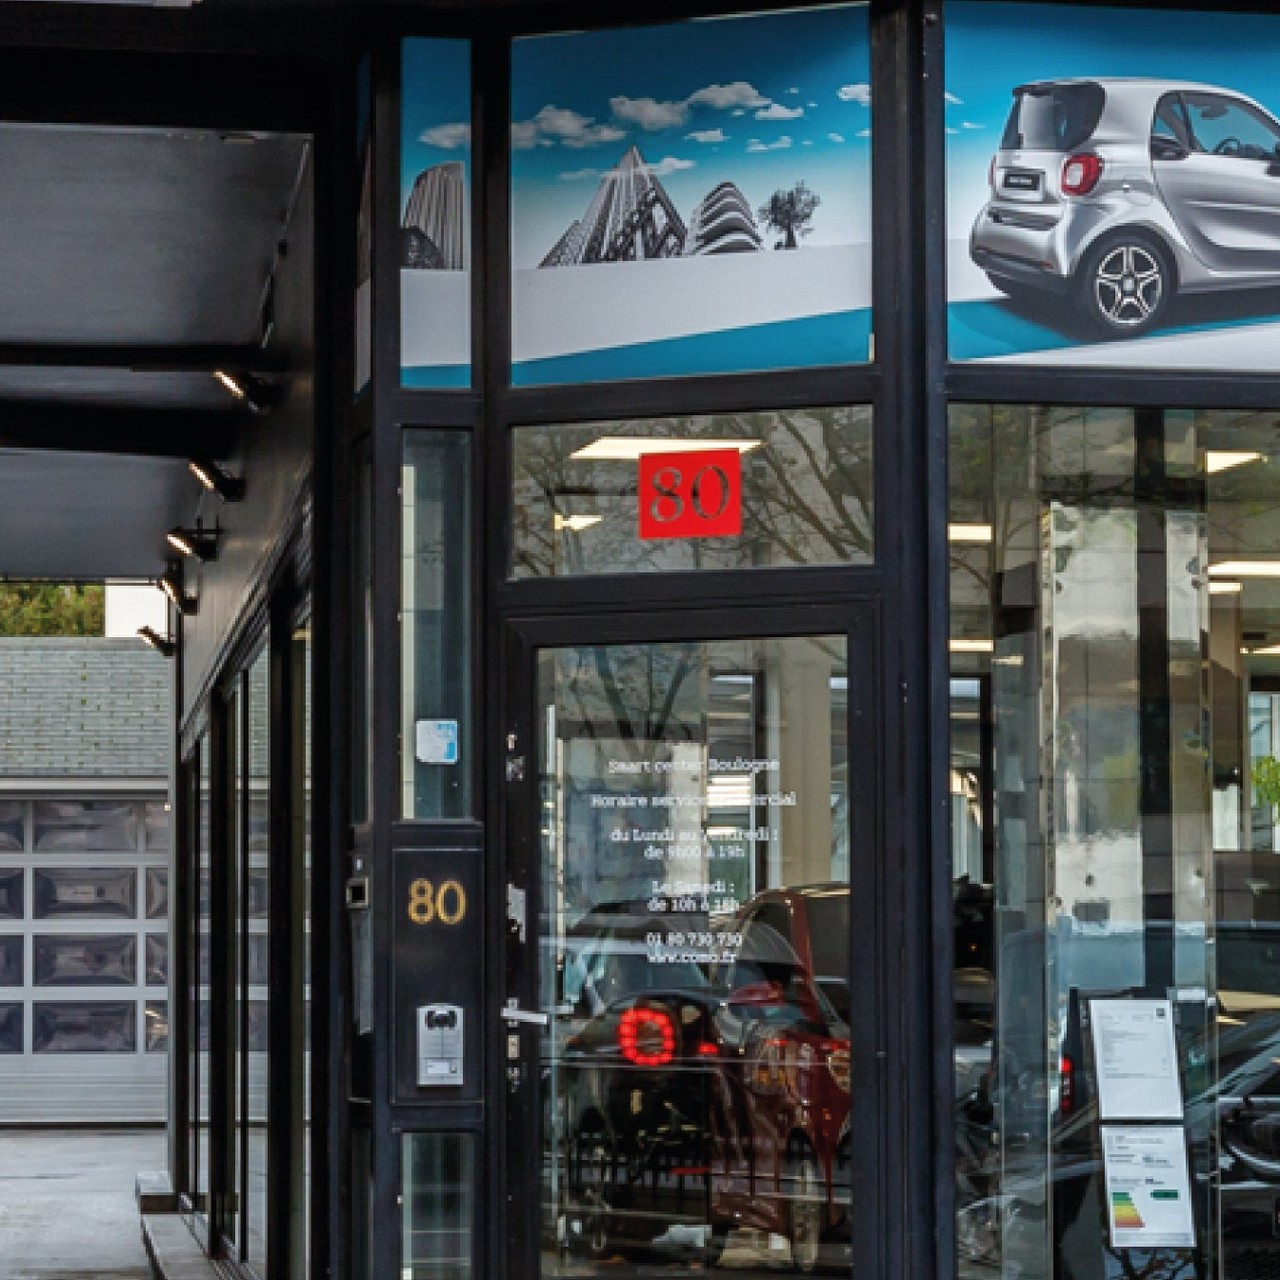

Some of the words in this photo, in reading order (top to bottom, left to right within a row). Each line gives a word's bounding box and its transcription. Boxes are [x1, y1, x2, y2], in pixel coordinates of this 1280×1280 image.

[648, 463, 729, 523] 80
[611, 827, 630, 842] du
[632, 827, 675, 842] Lundi
[407, 878, 467, 925] 80
